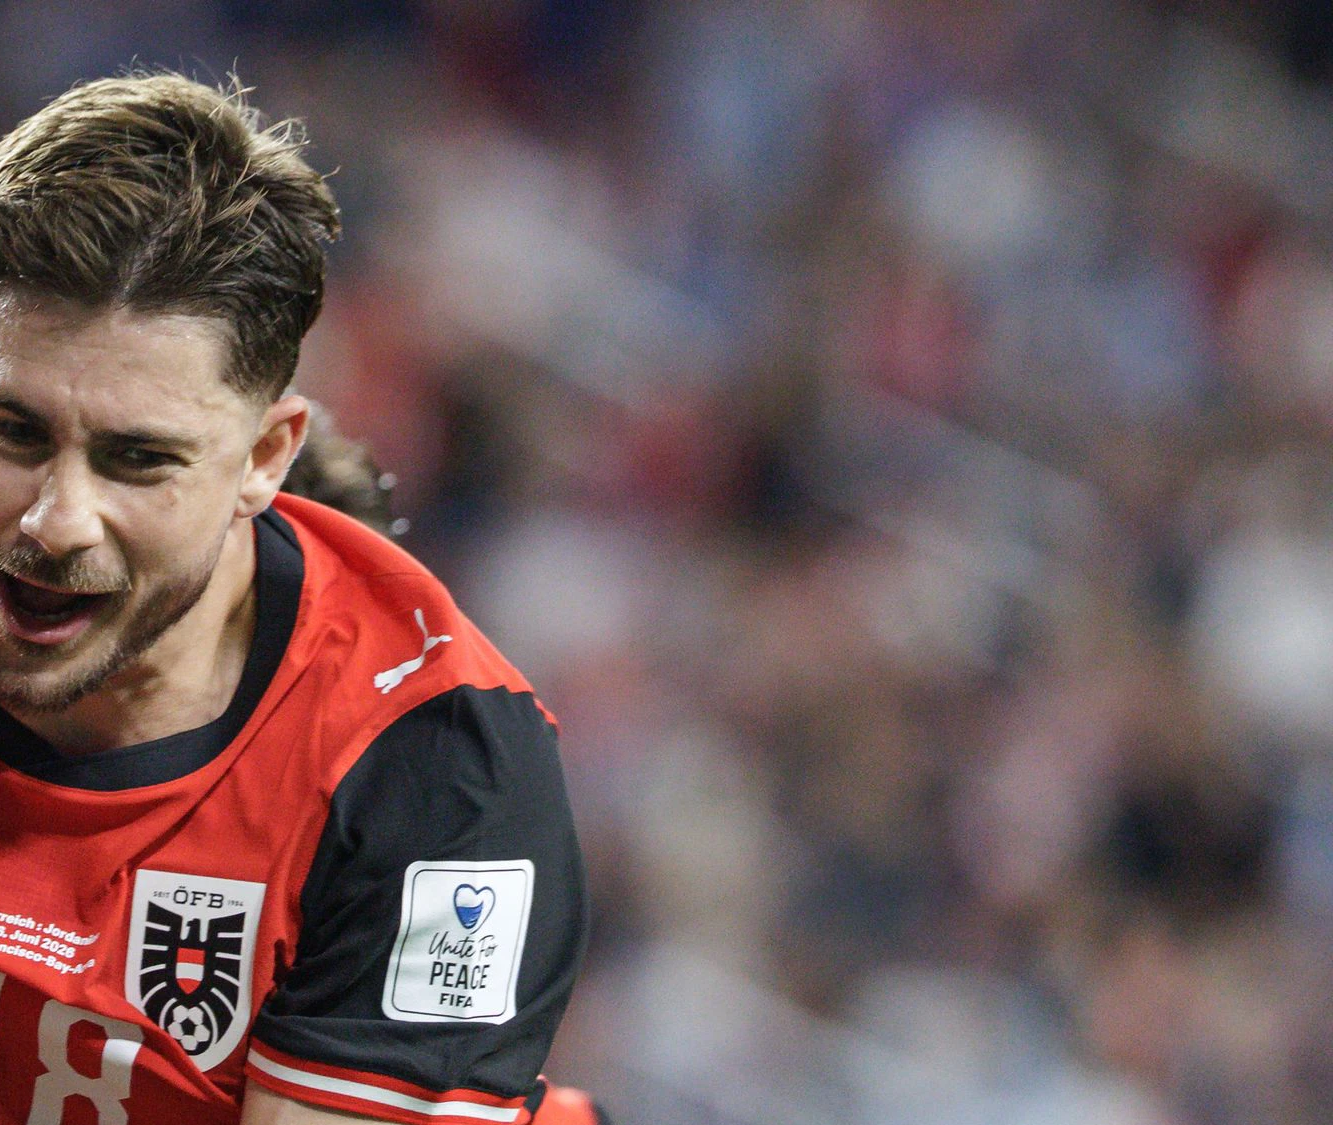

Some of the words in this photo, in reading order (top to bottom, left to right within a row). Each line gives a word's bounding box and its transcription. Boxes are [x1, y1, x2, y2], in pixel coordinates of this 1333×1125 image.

[173, 885, 224, 909] ÖFB
[9, 930, 41, 946] Juni
[40, 938, 77, 958] 2026
[428, 931, 475, 959] Unite
[478, 934, 498, 960] For
[429, 961, 490, 990] PEACE
[439, 993, 473, 1008] FIFA
